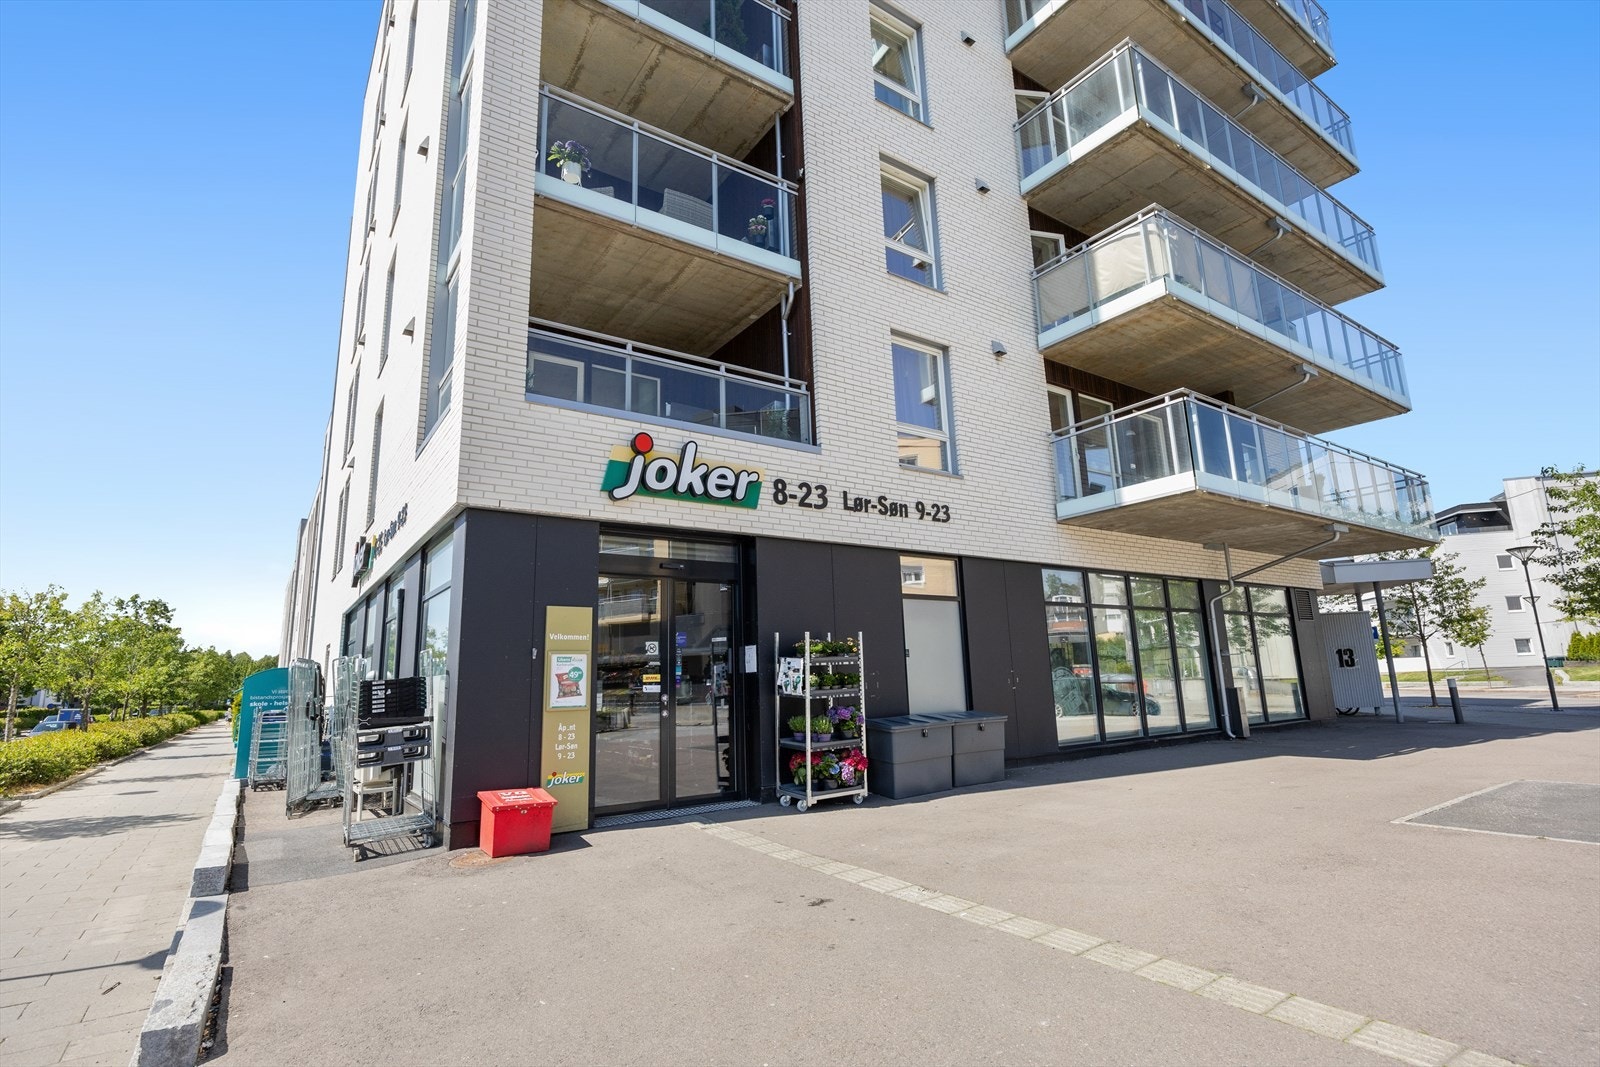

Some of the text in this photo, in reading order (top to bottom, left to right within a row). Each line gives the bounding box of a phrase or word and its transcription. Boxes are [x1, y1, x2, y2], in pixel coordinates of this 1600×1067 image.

[609, 432, 759, 502] joker
[772, 478, 951, 523] 8-23 Lør-Søn 9-23
[1335, 648, 1356, 668] 13
[558, 722, 576, 732] Åpnt
[558, 733, 563, 741] 8
[567, 732, 576, 740] 23
[557, 752, 562, 760] 9
[567, 751, 576, 759] 23
[547, 771, 583, 788] joker
